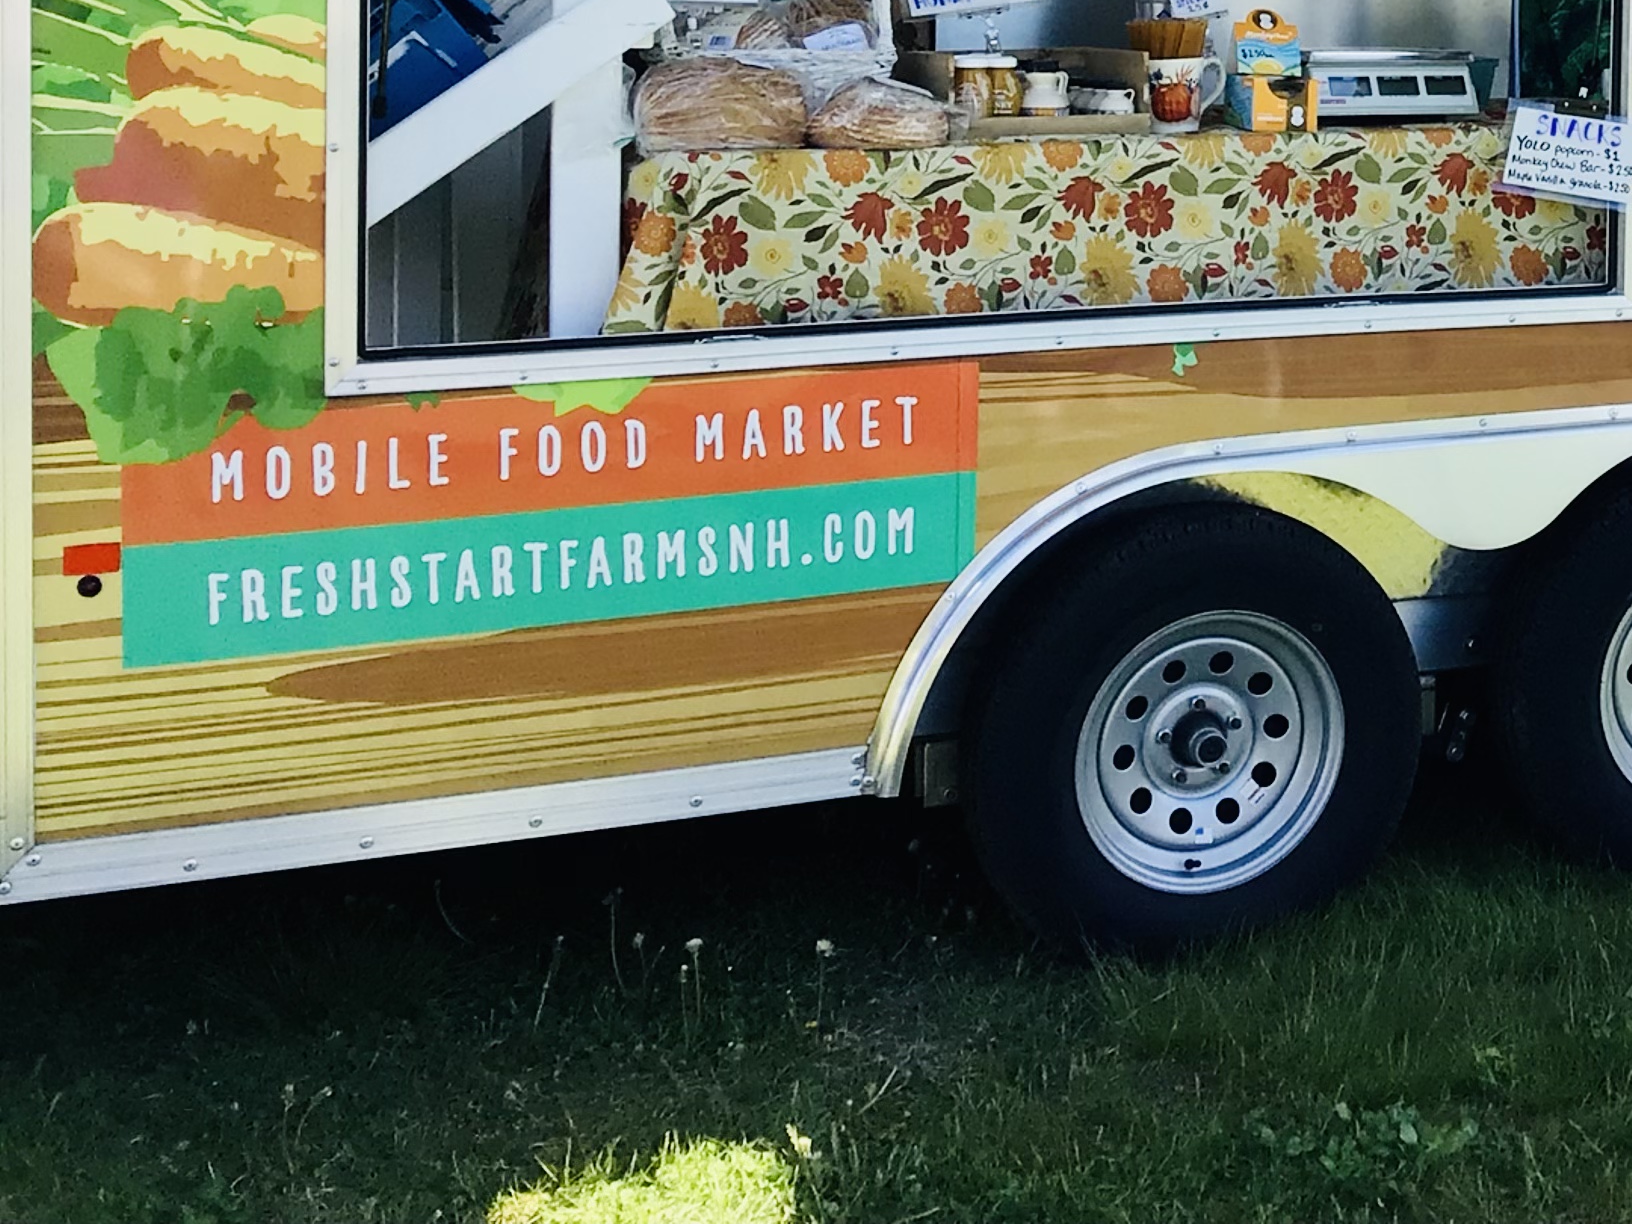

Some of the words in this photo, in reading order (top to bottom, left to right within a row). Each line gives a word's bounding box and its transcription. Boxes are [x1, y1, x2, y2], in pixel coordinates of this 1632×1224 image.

[1536, 114, 1622, 147] SNACKS
[1512, 154, 1549, 170] Monkey
[1517, 135, 1551, 152] YOLO
[1555, 145, 1594, 158] popcorn
[1604, 149, 1620, 162] $1
[211, 432, 450, 504] MOBILE
[499, 417, 647, 482] FOOD
[695, 395, 919, 464] MARKET
[207, 506, 917, 627] FRESHSTARTFARMSNH.COM
